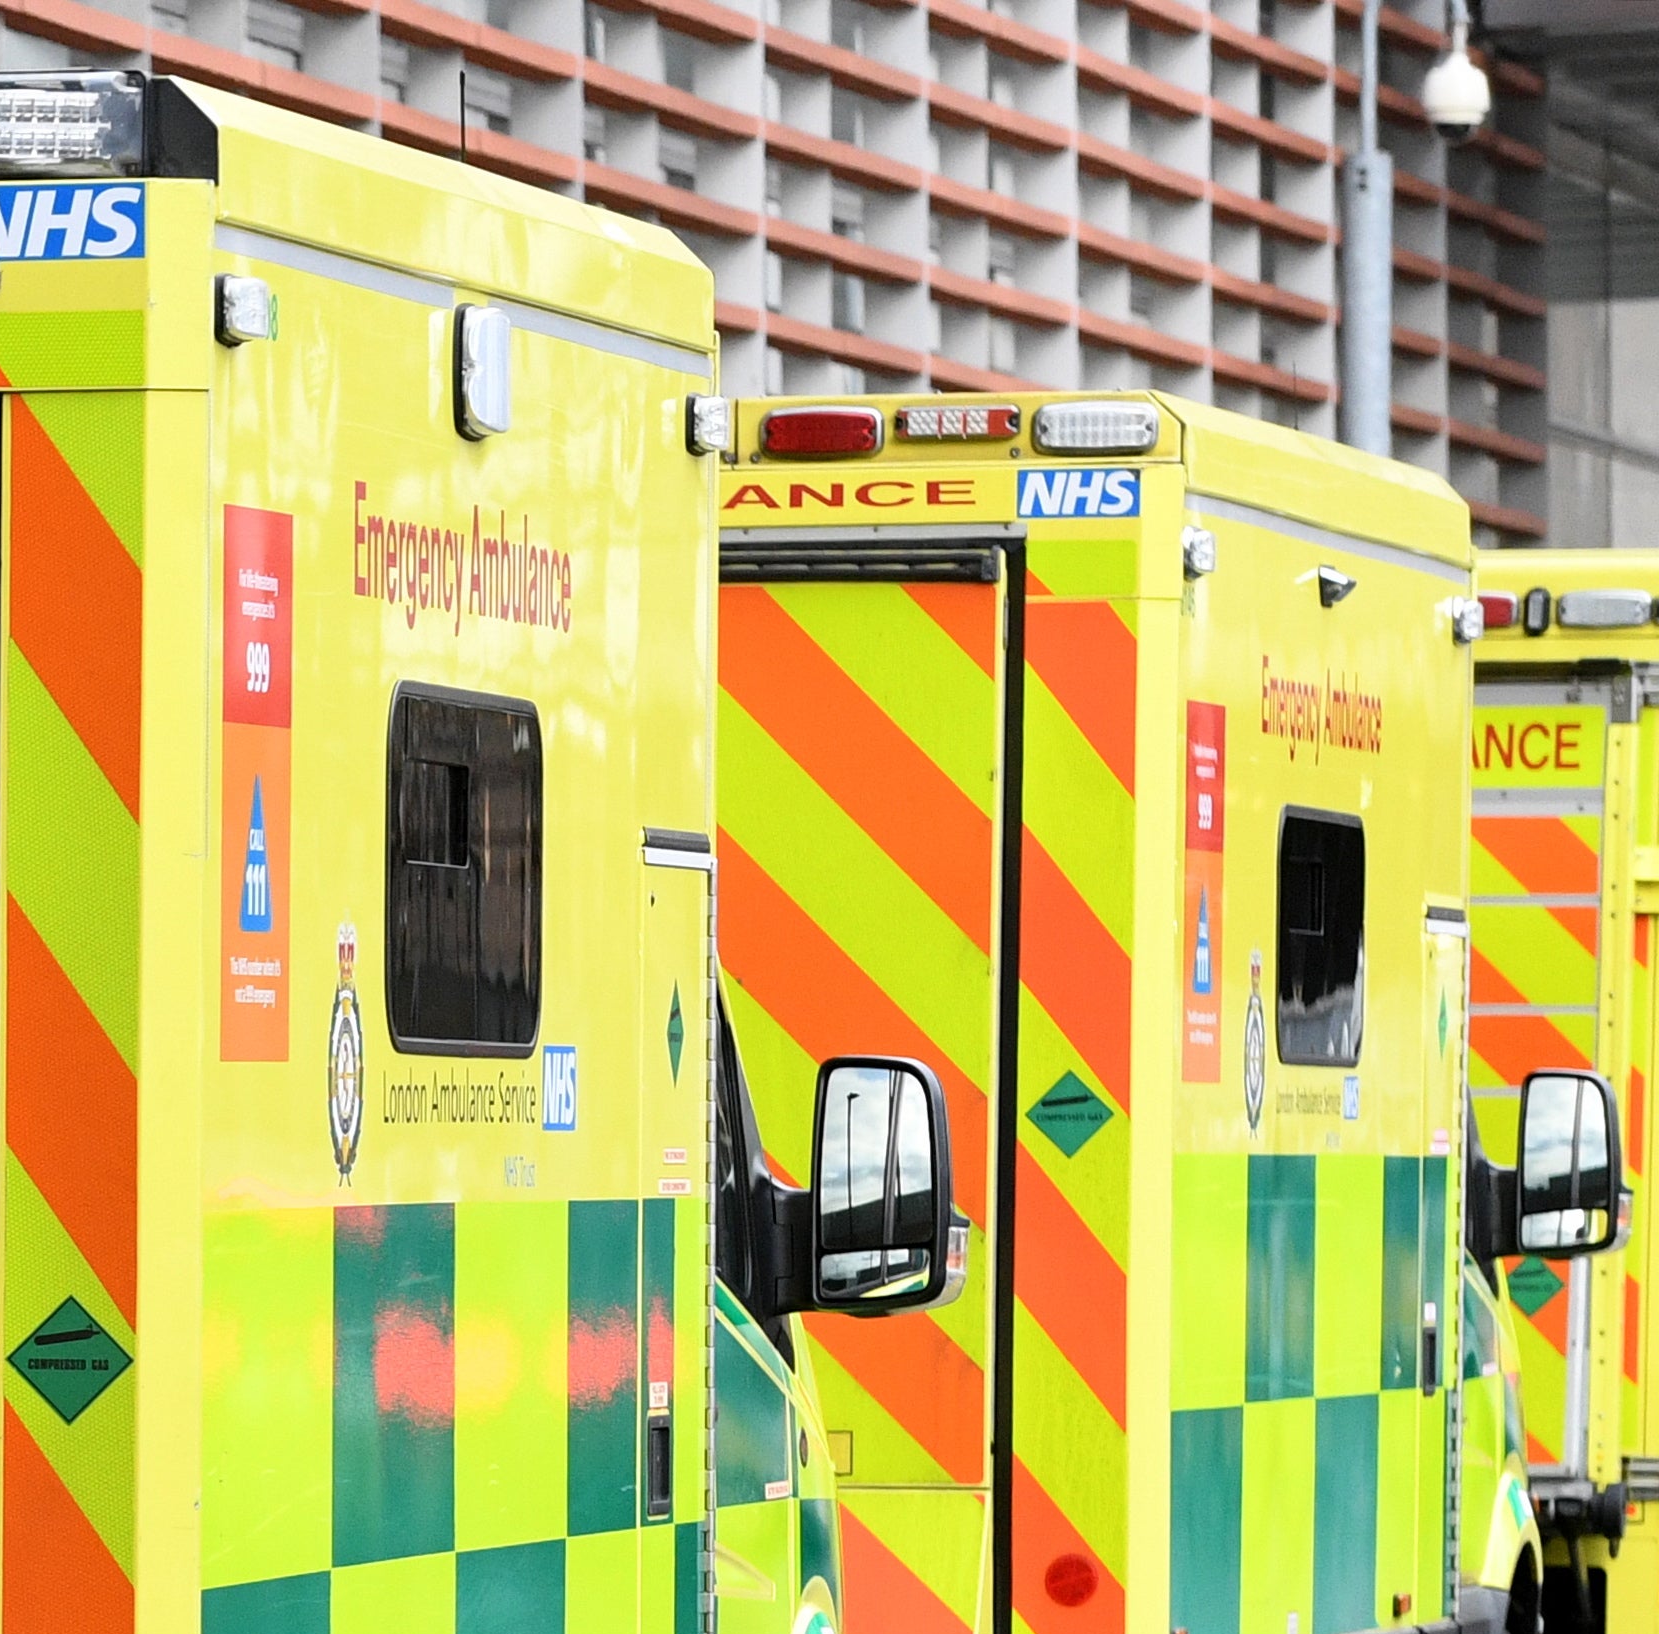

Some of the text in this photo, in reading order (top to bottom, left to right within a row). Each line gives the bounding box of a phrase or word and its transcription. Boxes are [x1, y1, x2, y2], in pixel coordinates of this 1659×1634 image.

[1019, 469, 1137, 517] NHS
[354, 480, 571, 637] Emergency Ambulance
[246, 641, 271, 693] 999
[1262, 654, 1382, 766] Emergency Ambulance
[249, 829, 265, 851] CALL
[246, 863, 266, 916] 111
[383, 1067, 536, 1124] London Ambulance Service
[543, 1052, 575, 1126] NHS
[28, 1359, 109, 1371] COMPRESSED GAS
